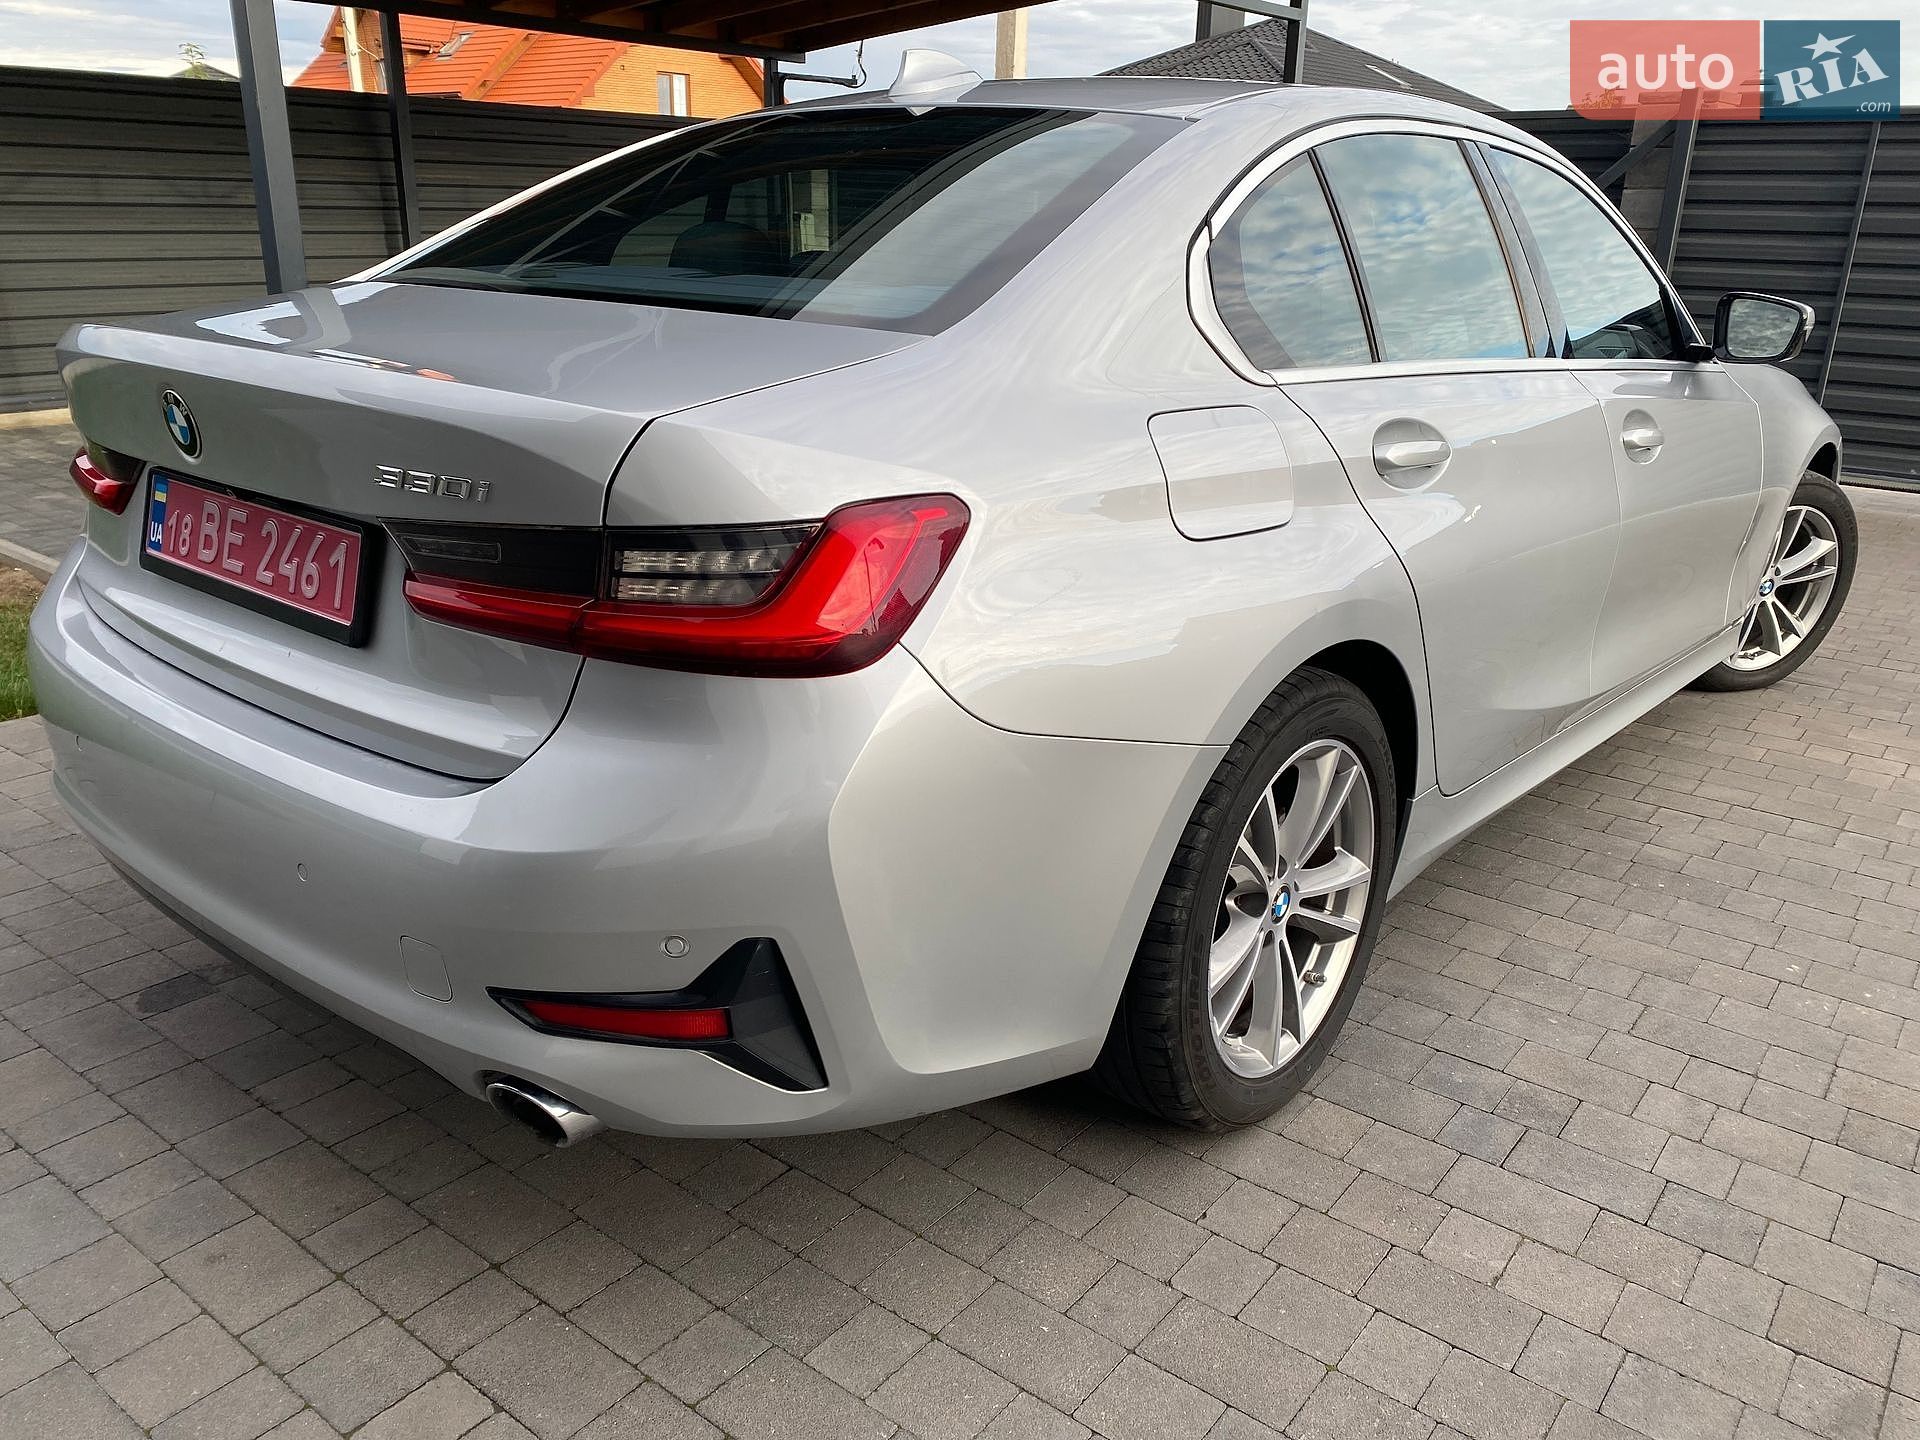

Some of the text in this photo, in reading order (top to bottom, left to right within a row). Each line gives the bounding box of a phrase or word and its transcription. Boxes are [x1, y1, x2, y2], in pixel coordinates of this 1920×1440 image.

[373, 464, 491, 502] 330i
[150, 521, 162, 545] UA
[168, 499, 349, 610] 18 BE 2461
